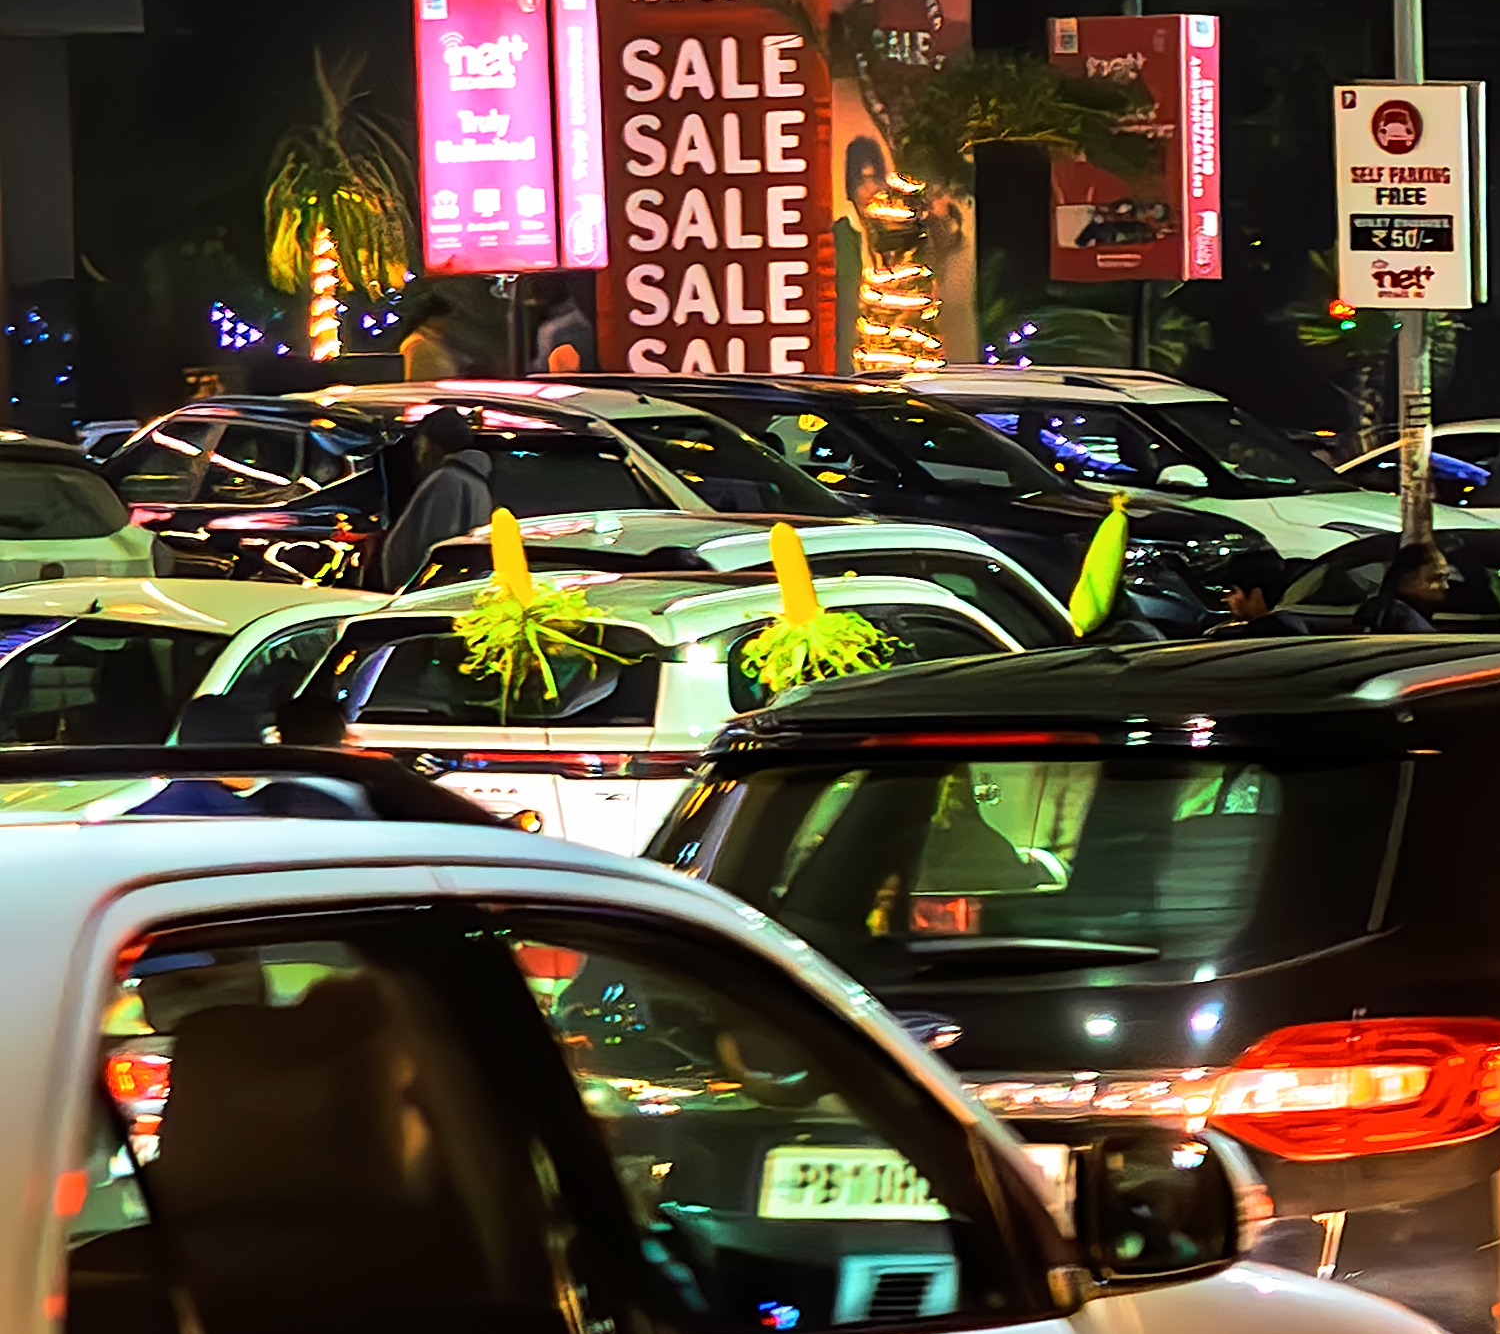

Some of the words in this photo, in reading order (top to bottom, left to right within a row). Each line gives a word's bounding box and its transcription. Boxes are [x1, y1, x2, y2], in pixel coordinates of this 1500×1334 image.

[622, 34, 806, 103] SALE
[622, 109, 808, 177] SALE
[624, 185, 809, 252] SALE
[1376, 187, 1427, 205] FREE
[626, 261, 811, 326] SALE
